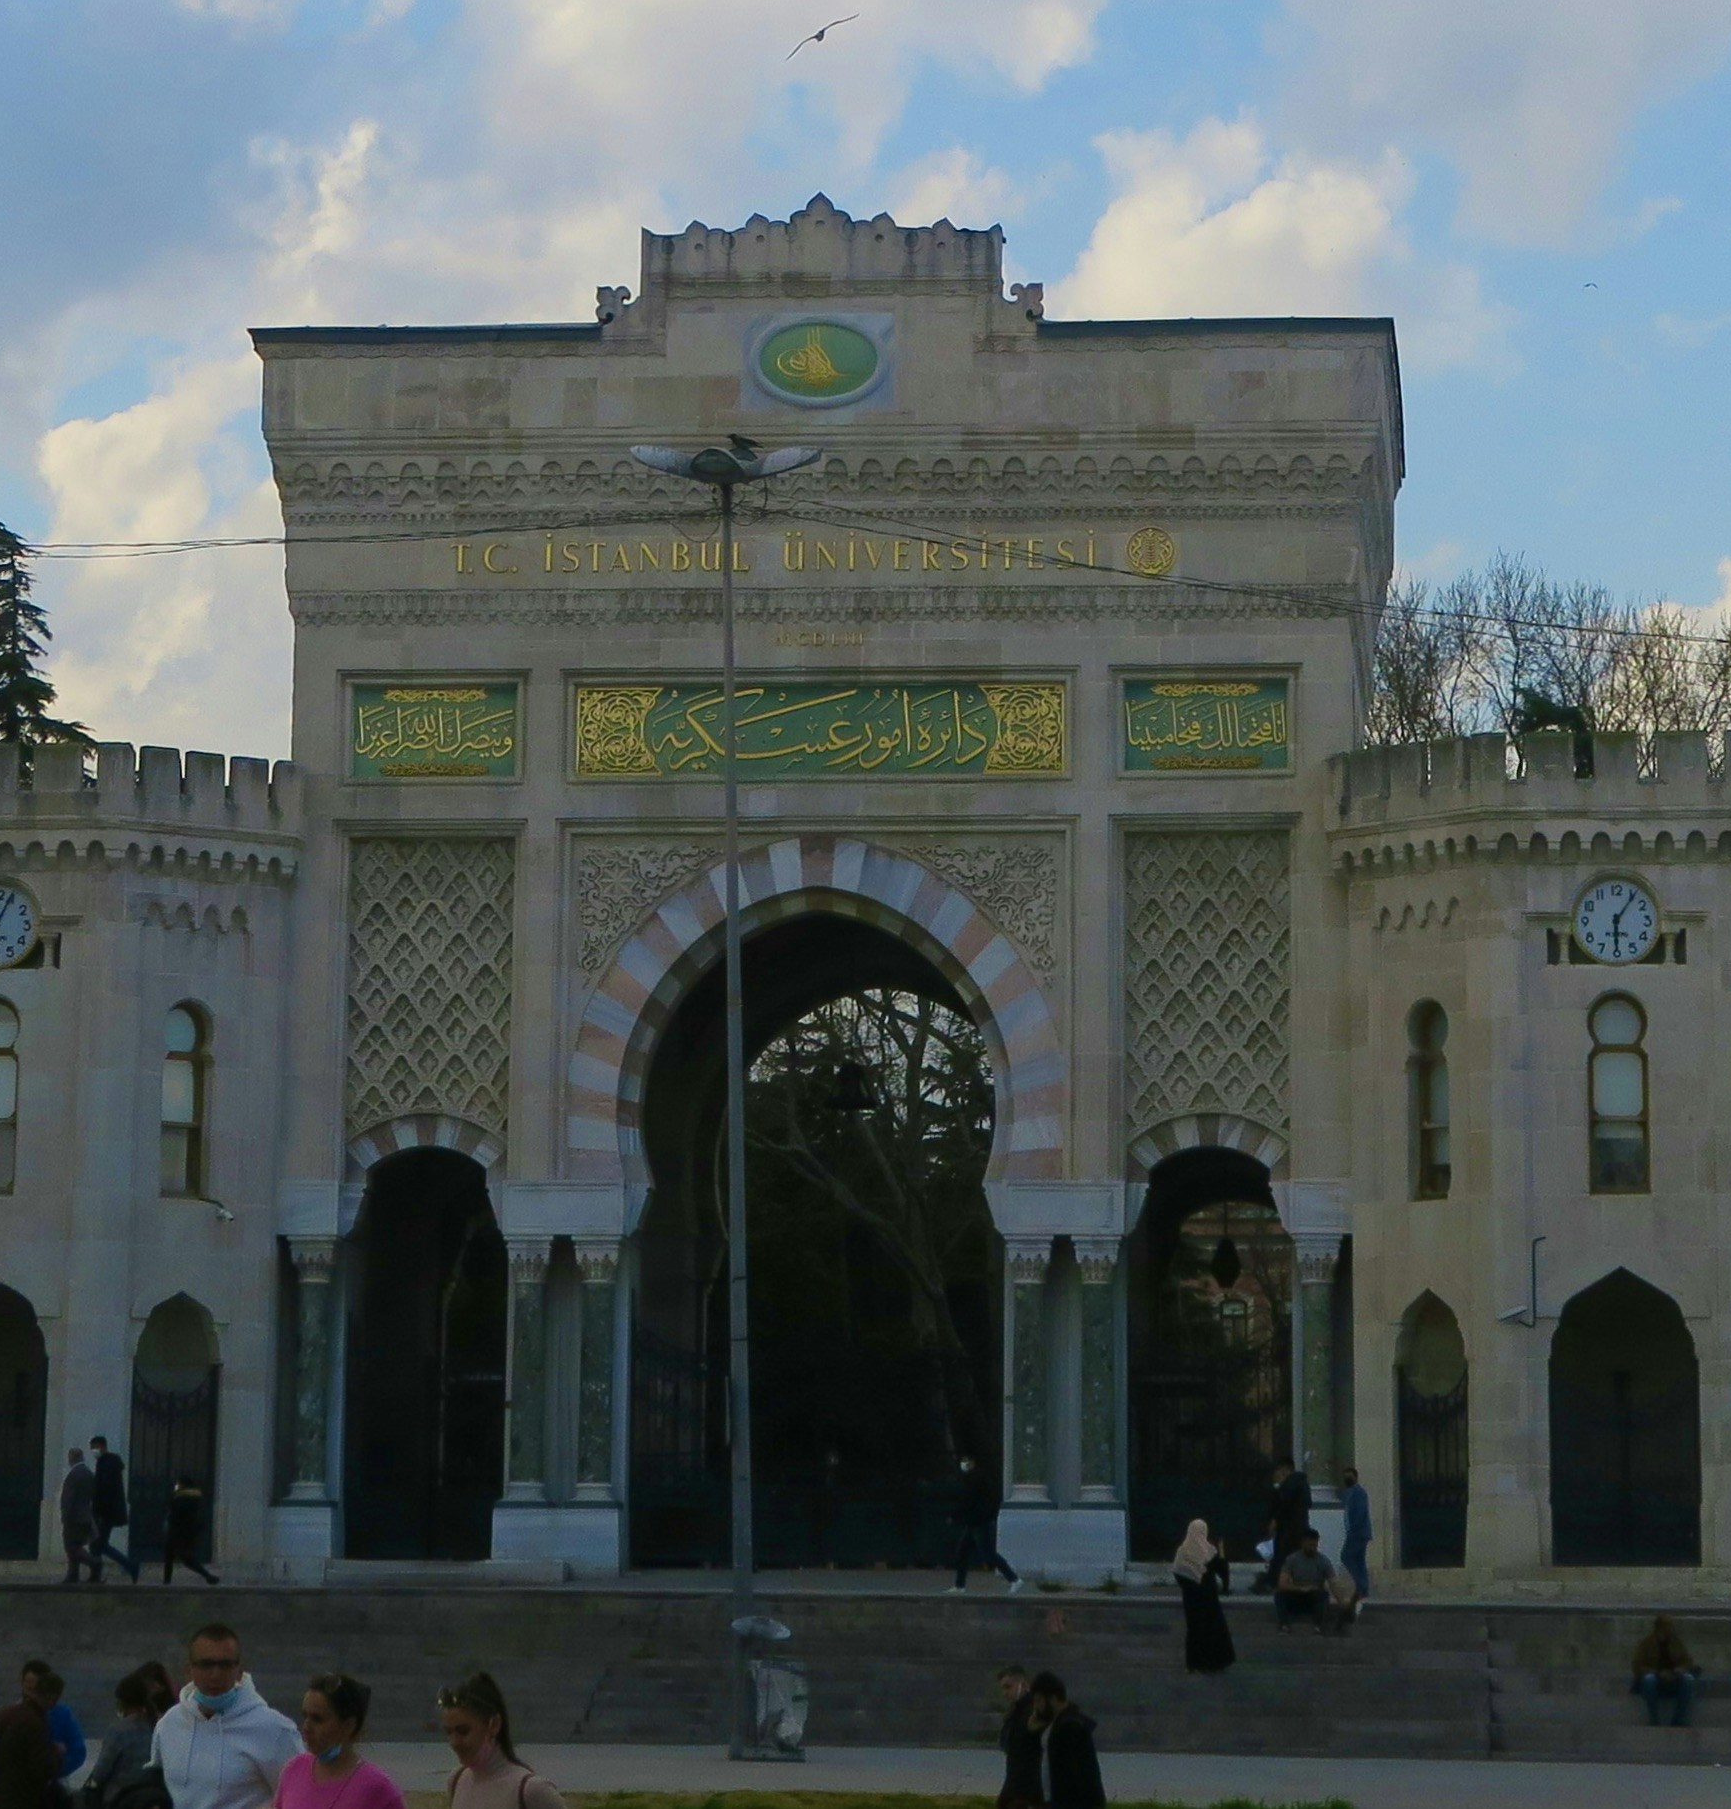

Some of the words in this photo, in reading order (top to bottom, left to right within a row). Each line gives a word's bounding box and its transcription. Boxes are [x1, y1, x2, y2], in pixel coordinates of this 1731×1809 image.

[450, 542, 518, 574] T.C.
[544, 533, 751, 573] İSTANBUL
[782, 529, 1096, 572] ÜNİVERSİTESİ
[1596, 889, 1604, 900] 11
[1611, 885, 1623, 896] 12
[19, 904, 27, 916] 2
[1584, 900, 1594, 912] 10
[1638, 900, 1646, 911] 2
[23, 920, 31, 931] 3
[1581, 916, 1589, 927] 9
[1643, 915, 1652, 927] 3
[17, 935, 25, 945] 4
[1585, 932, 1594, 943] 8
[1639, 931, 1648, 941] 4
[6, 946, 14, 957] 5
[1597, 943, 1606, 954] 7
[1628, 942, 1637, 954] 5
